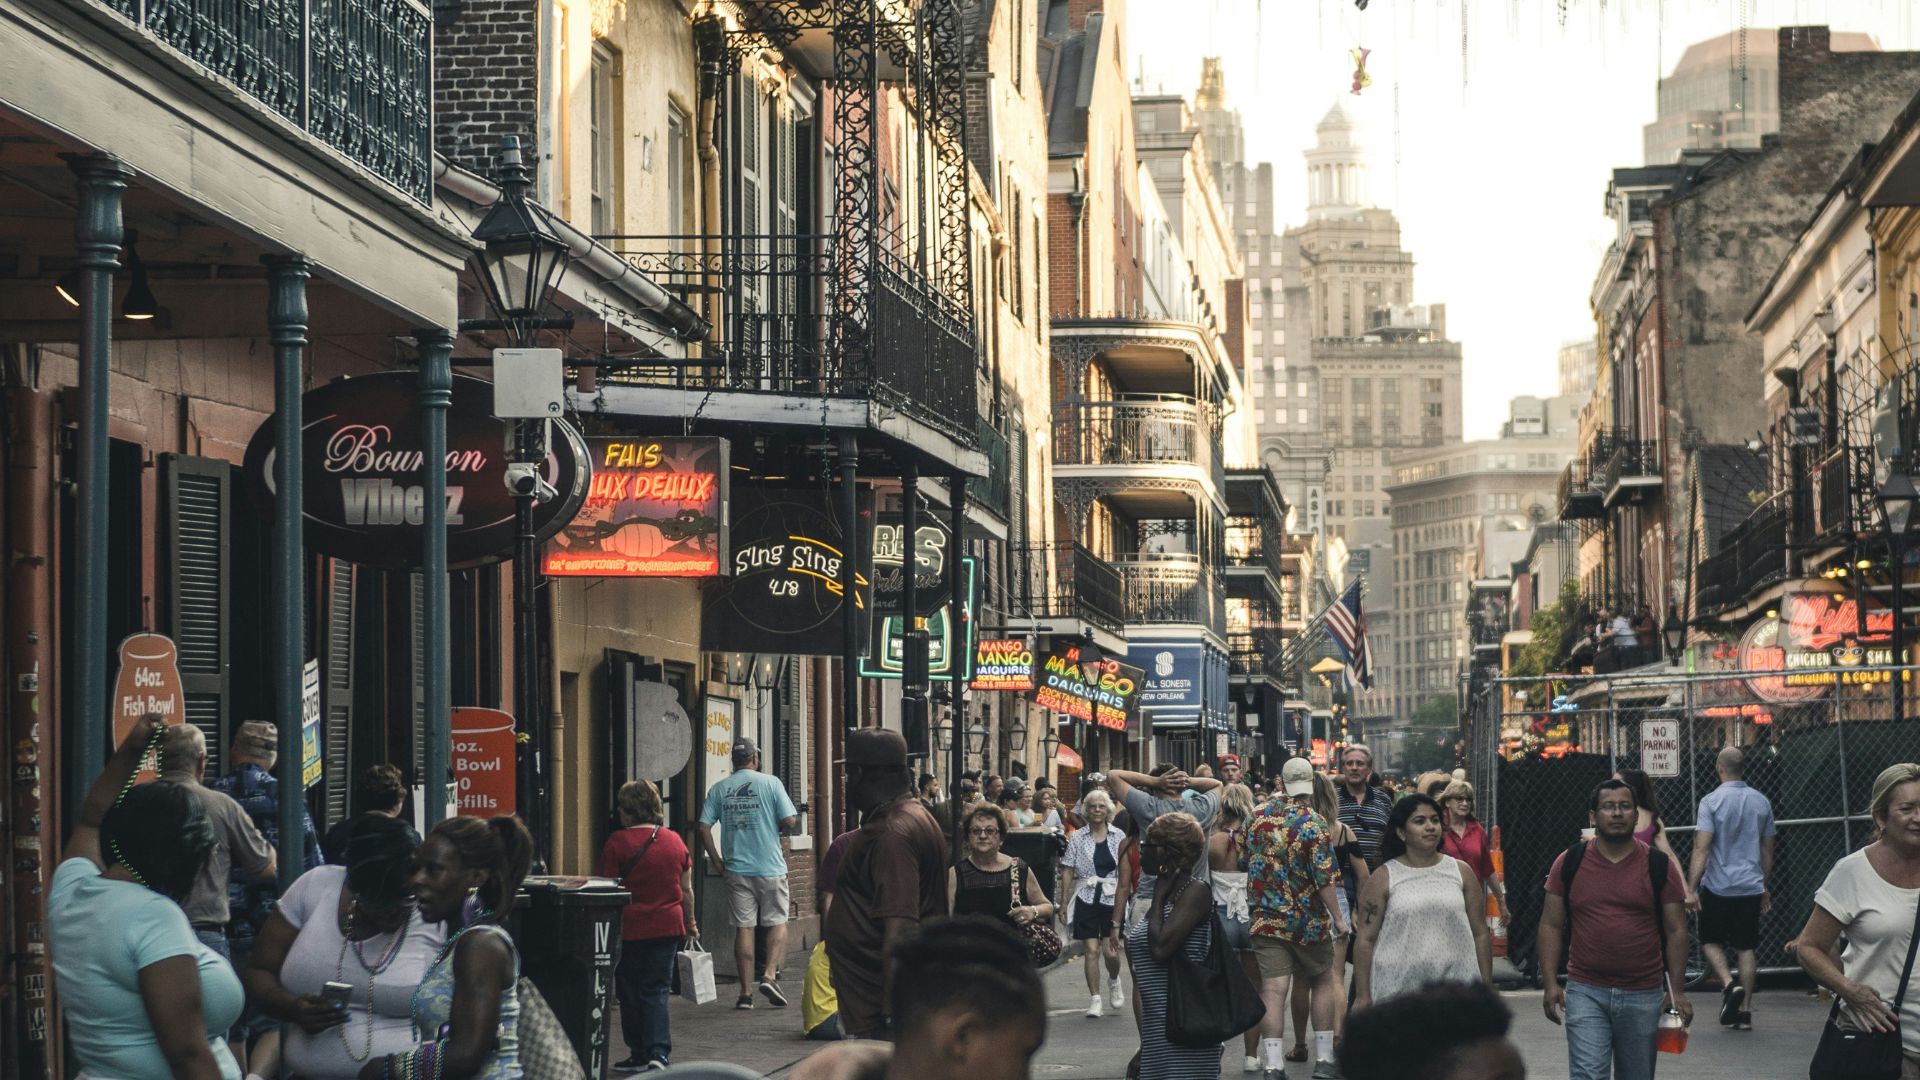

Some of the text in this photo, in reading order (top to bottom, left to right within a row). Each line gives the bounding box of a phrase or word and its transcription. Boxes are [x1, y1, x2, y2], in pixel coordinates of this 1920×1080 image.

[323, 424, 487, 473] Bouron
[604, 443, 662, 469] FAIS
[635, 473, 715, 501] DEAUX
[340, 478, 464, 525] Vibez
[736, 544, 842, 578] Sing Sing
[979, 641, 1023, 652] MANGO
[1787, 652, 1831, 667] CHICKEN
[135, 667, 165, 687] 64oz.
[976, 666, 1031, 675] AIQUIRIS
[1045, 656, 1134, 696] MAGO
[1883, 669, 1910, 682] BR
[1145, 680, 1192, 689] AL SONESTA
[123, 693, 174, 716] Fish Bowl
[1036, 693, 1061, 710] PIZZA
[1100, 714, 1125, 731] FOOD
[1039, 686, 1082, 706] COCKTAILS
[1098, 704, 1127, 720] BEER
[707, 712, 731, 732] SING
[1652, 726, 1667, 737] NO
[706, 739, 731, 756] SING
[1643, 740, 1677, 750] PARKING
[456, 757, 501, 771] Bowl
[457, 795, 498, 808] efills
